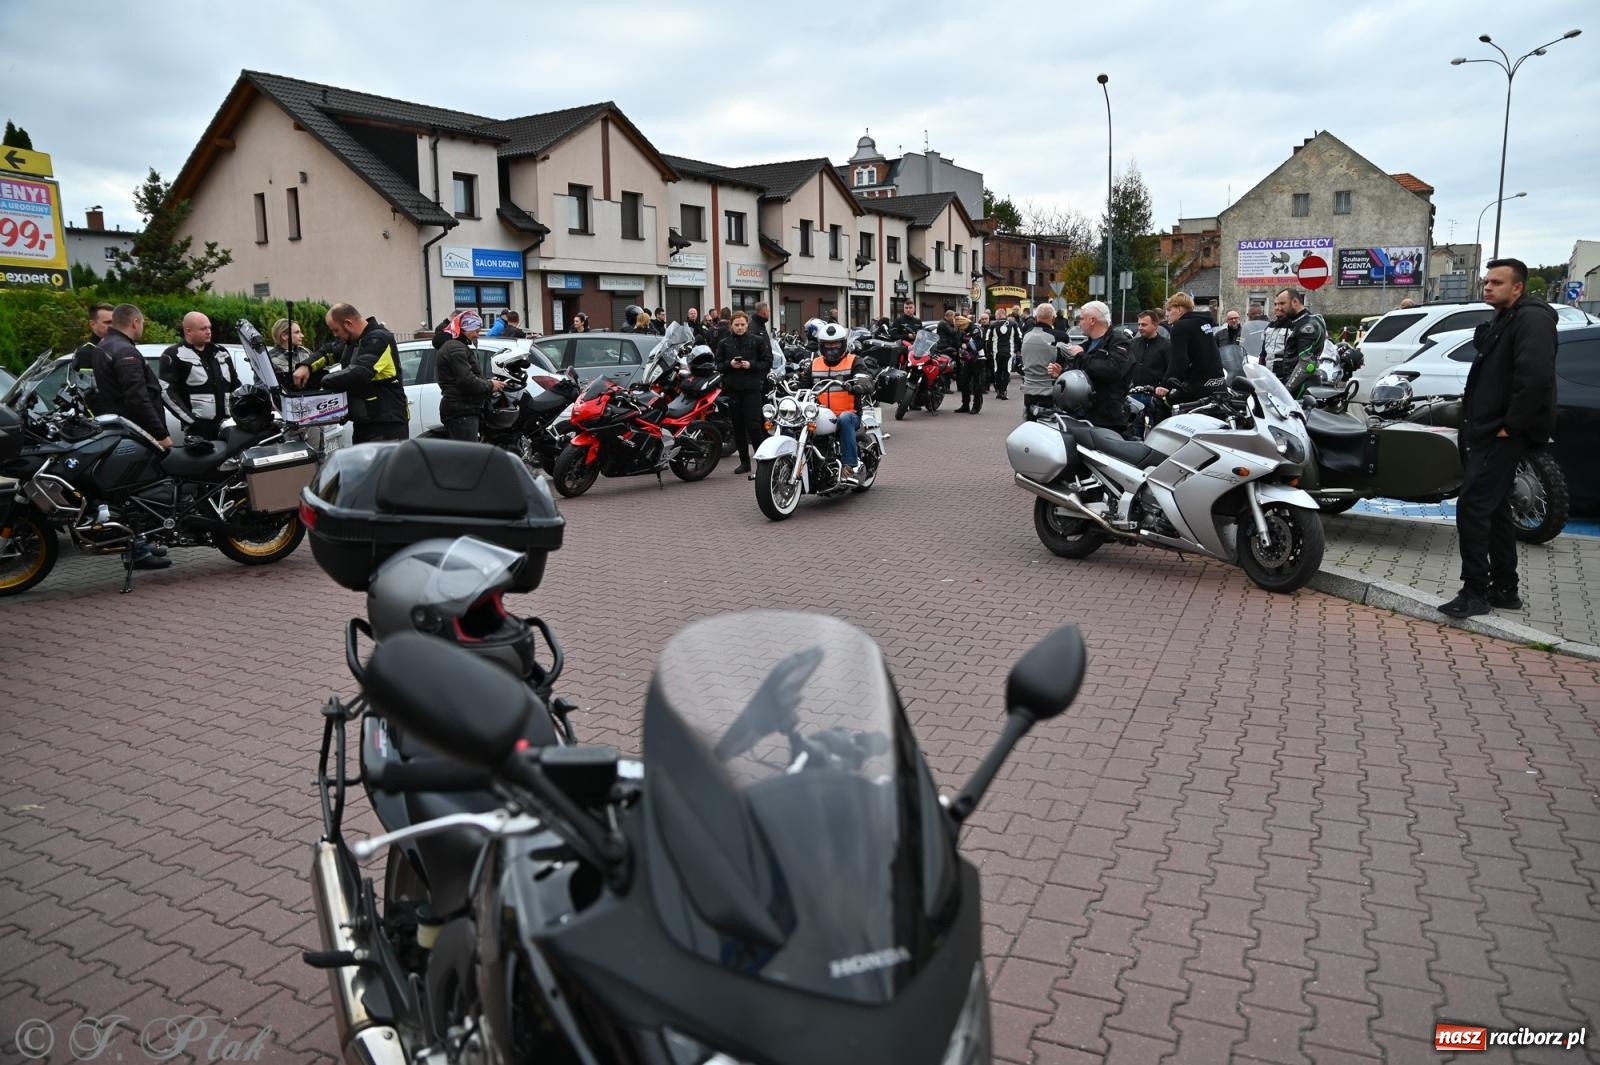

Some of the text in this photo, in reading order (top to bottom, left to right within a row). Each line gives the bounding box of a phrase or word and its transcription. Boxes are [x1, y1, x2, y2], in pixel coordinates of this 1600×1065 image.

[0, 182, 47, 203] ENY!
[8, 202, 49, 213] URODZINY
[1240, 239, 1330, 249] SALON DZIECIĘCY
[475, 259, 497, 267] SALON
